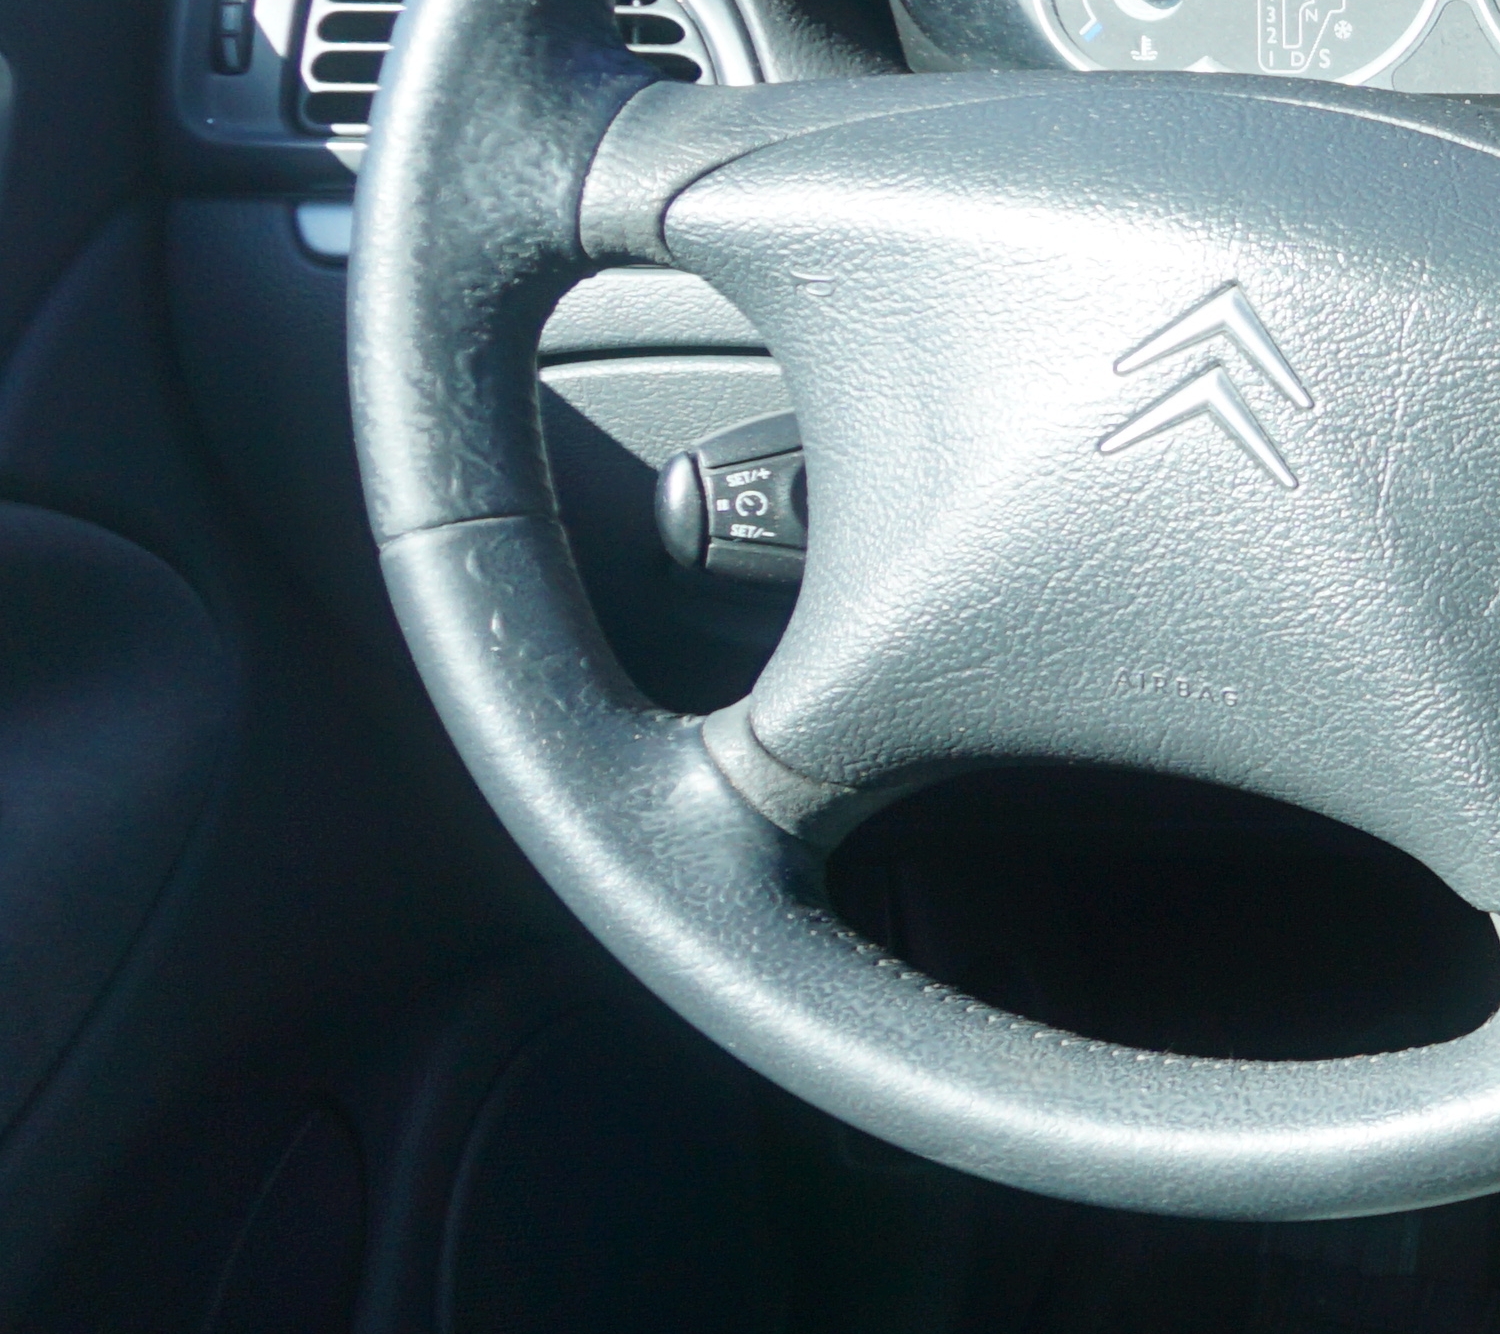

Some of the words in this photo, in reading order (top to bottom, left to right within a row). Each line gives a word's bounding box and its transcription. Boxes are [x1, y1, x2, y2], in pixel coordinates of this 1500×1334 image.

[1266, 7, 1276, 23] 3
[1305, 8, 1318, 22] N
[1266, 27, 1277, 44] 2
[1291, 51, 1304, 67] D
[1319, 49, 1331, 69] S
[726, 468, 772, 488] SET/+
[1114, 669, 1240, 708] AIRBAG
